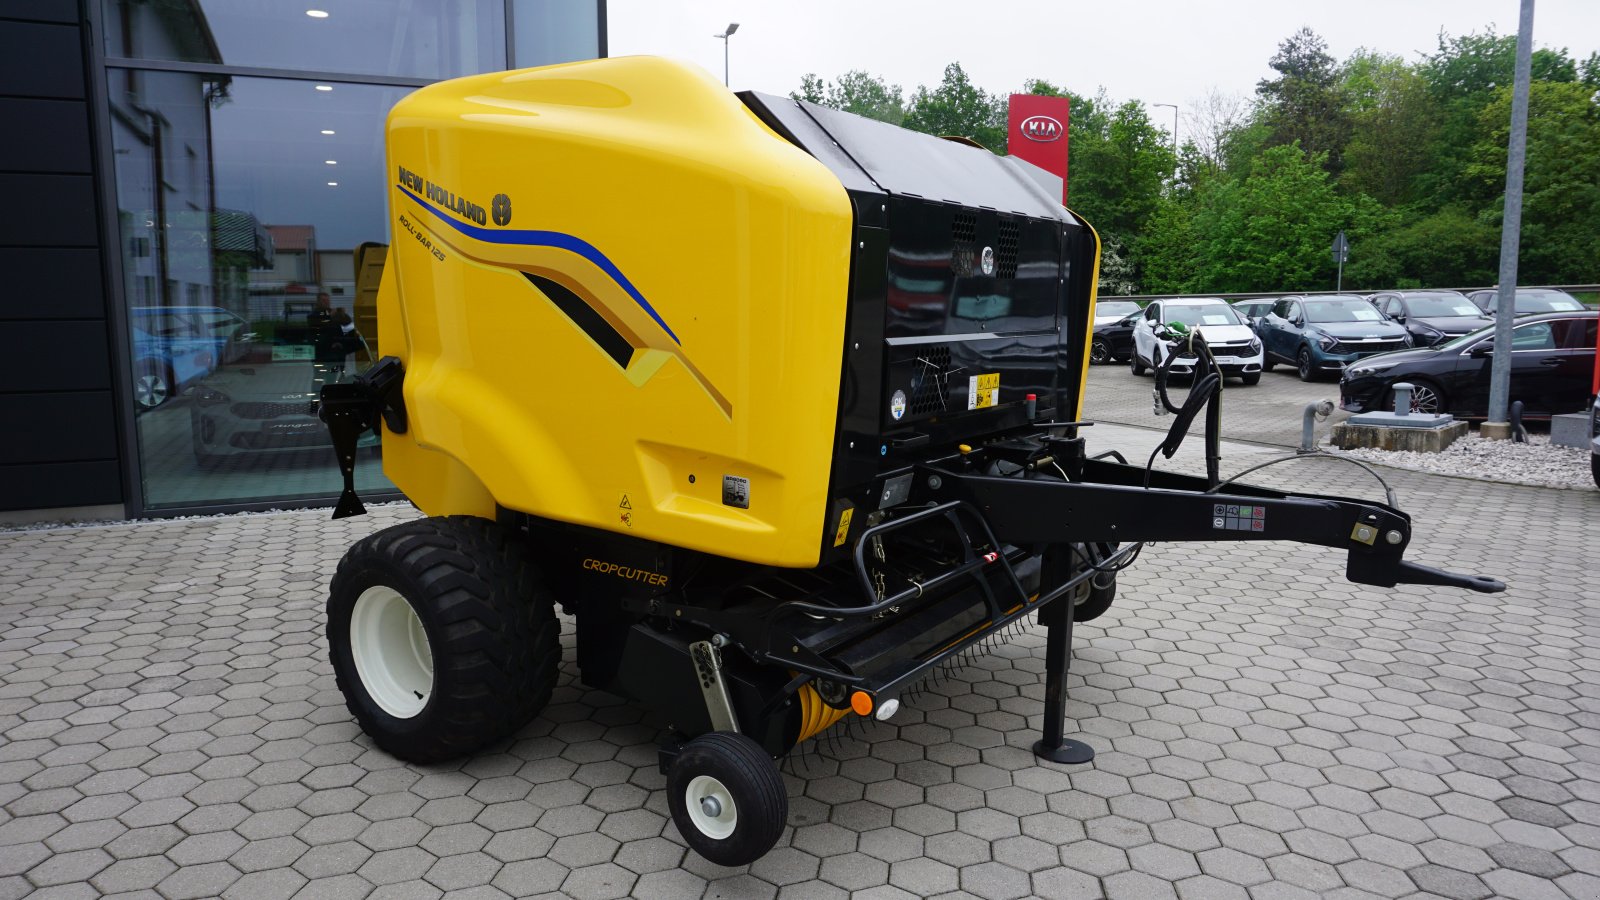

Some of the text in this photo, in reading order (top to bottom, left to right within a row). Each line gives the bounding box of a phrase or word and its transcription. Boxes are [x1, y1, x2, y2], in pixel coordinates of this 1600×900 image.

[1029, 121, 1056, 136] KIA
[399, 165, 487, 226] NEW HOLLAND
[399, 215, 446, 262] ROLL-BAR 125
[583, 559, 668, 586] CROPCUTTER
